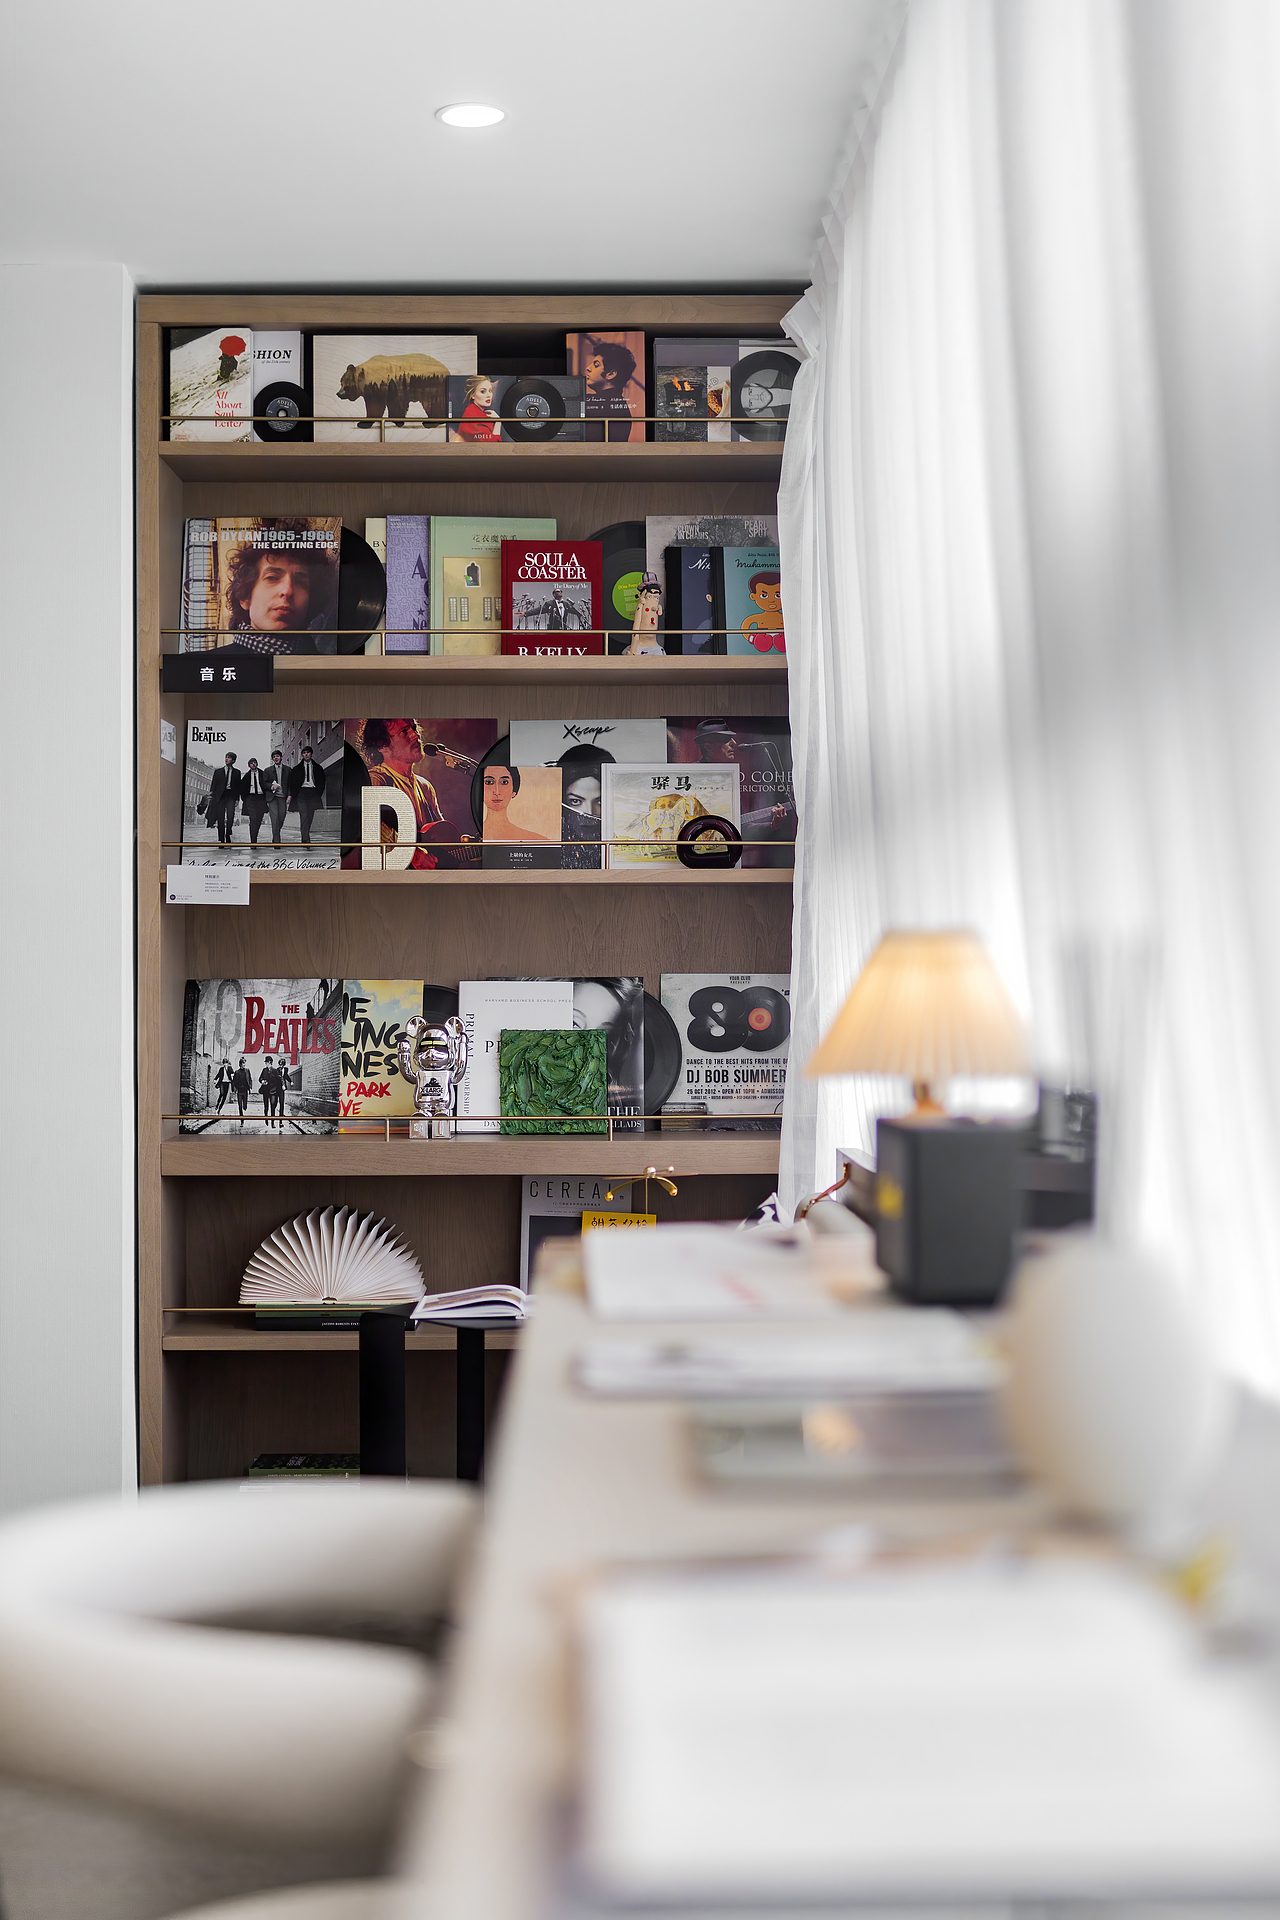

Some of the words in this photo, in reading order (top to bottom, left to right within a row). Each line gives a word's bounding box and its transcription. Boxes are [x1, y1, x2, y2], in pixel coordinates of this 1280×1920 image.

[215, 391, 228, 399] All
[215, 401, 242, 409] About
[744, 520, 767, 529] PEARL
[189, 531, 218, 542] BOB
[252, 541, 269, 549] THE
[271, 541, 313, 549] CUTTING
[315, 541, 339, 549] EDGE
[524, 552, 581, 567] SOULA
[517, 565, 588, 580] COASTER
[199, 666, 237, 682] 音乐
[273, 858, 294, 870] BBC
[296, 858, 326, 869] Volume
[281, 1004, 300, 1014] THE
[243, 997, 336, 1066] BEATLES
[686, 1069, 700, 1083] DJ
[705, 1069, 729, 1083] BOB
[347, 1081, 392, 1098] PARK
